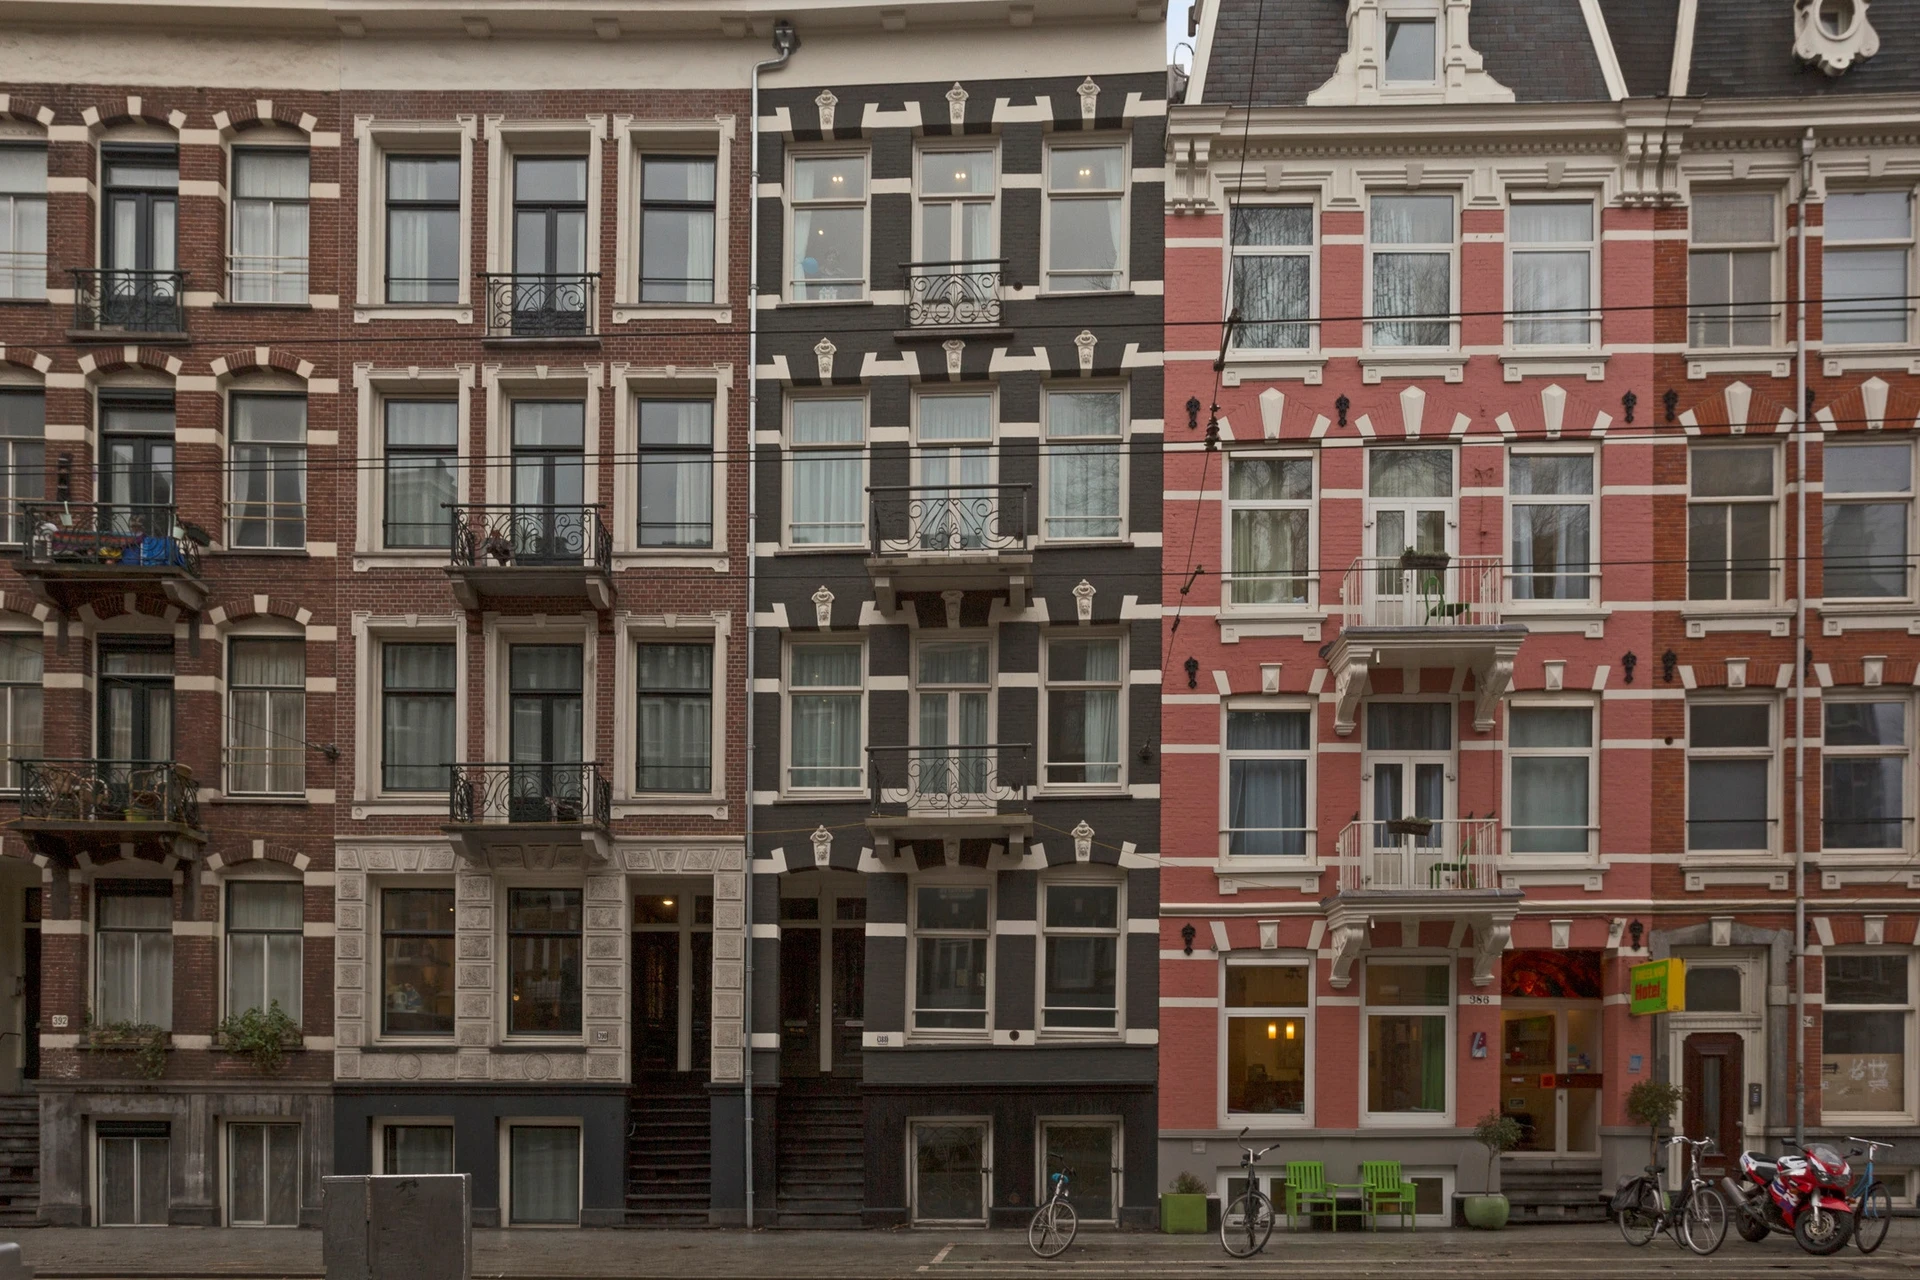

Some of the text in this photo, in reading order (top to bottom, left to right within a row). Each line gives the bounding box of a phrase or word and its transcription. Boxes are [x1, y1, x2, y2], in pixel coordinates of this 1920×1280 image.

[1635, 981, 1660, 1001] Hotel
[1469, 995, 1489, 1004] 386
[53, 1016, 68, 1025] 392
